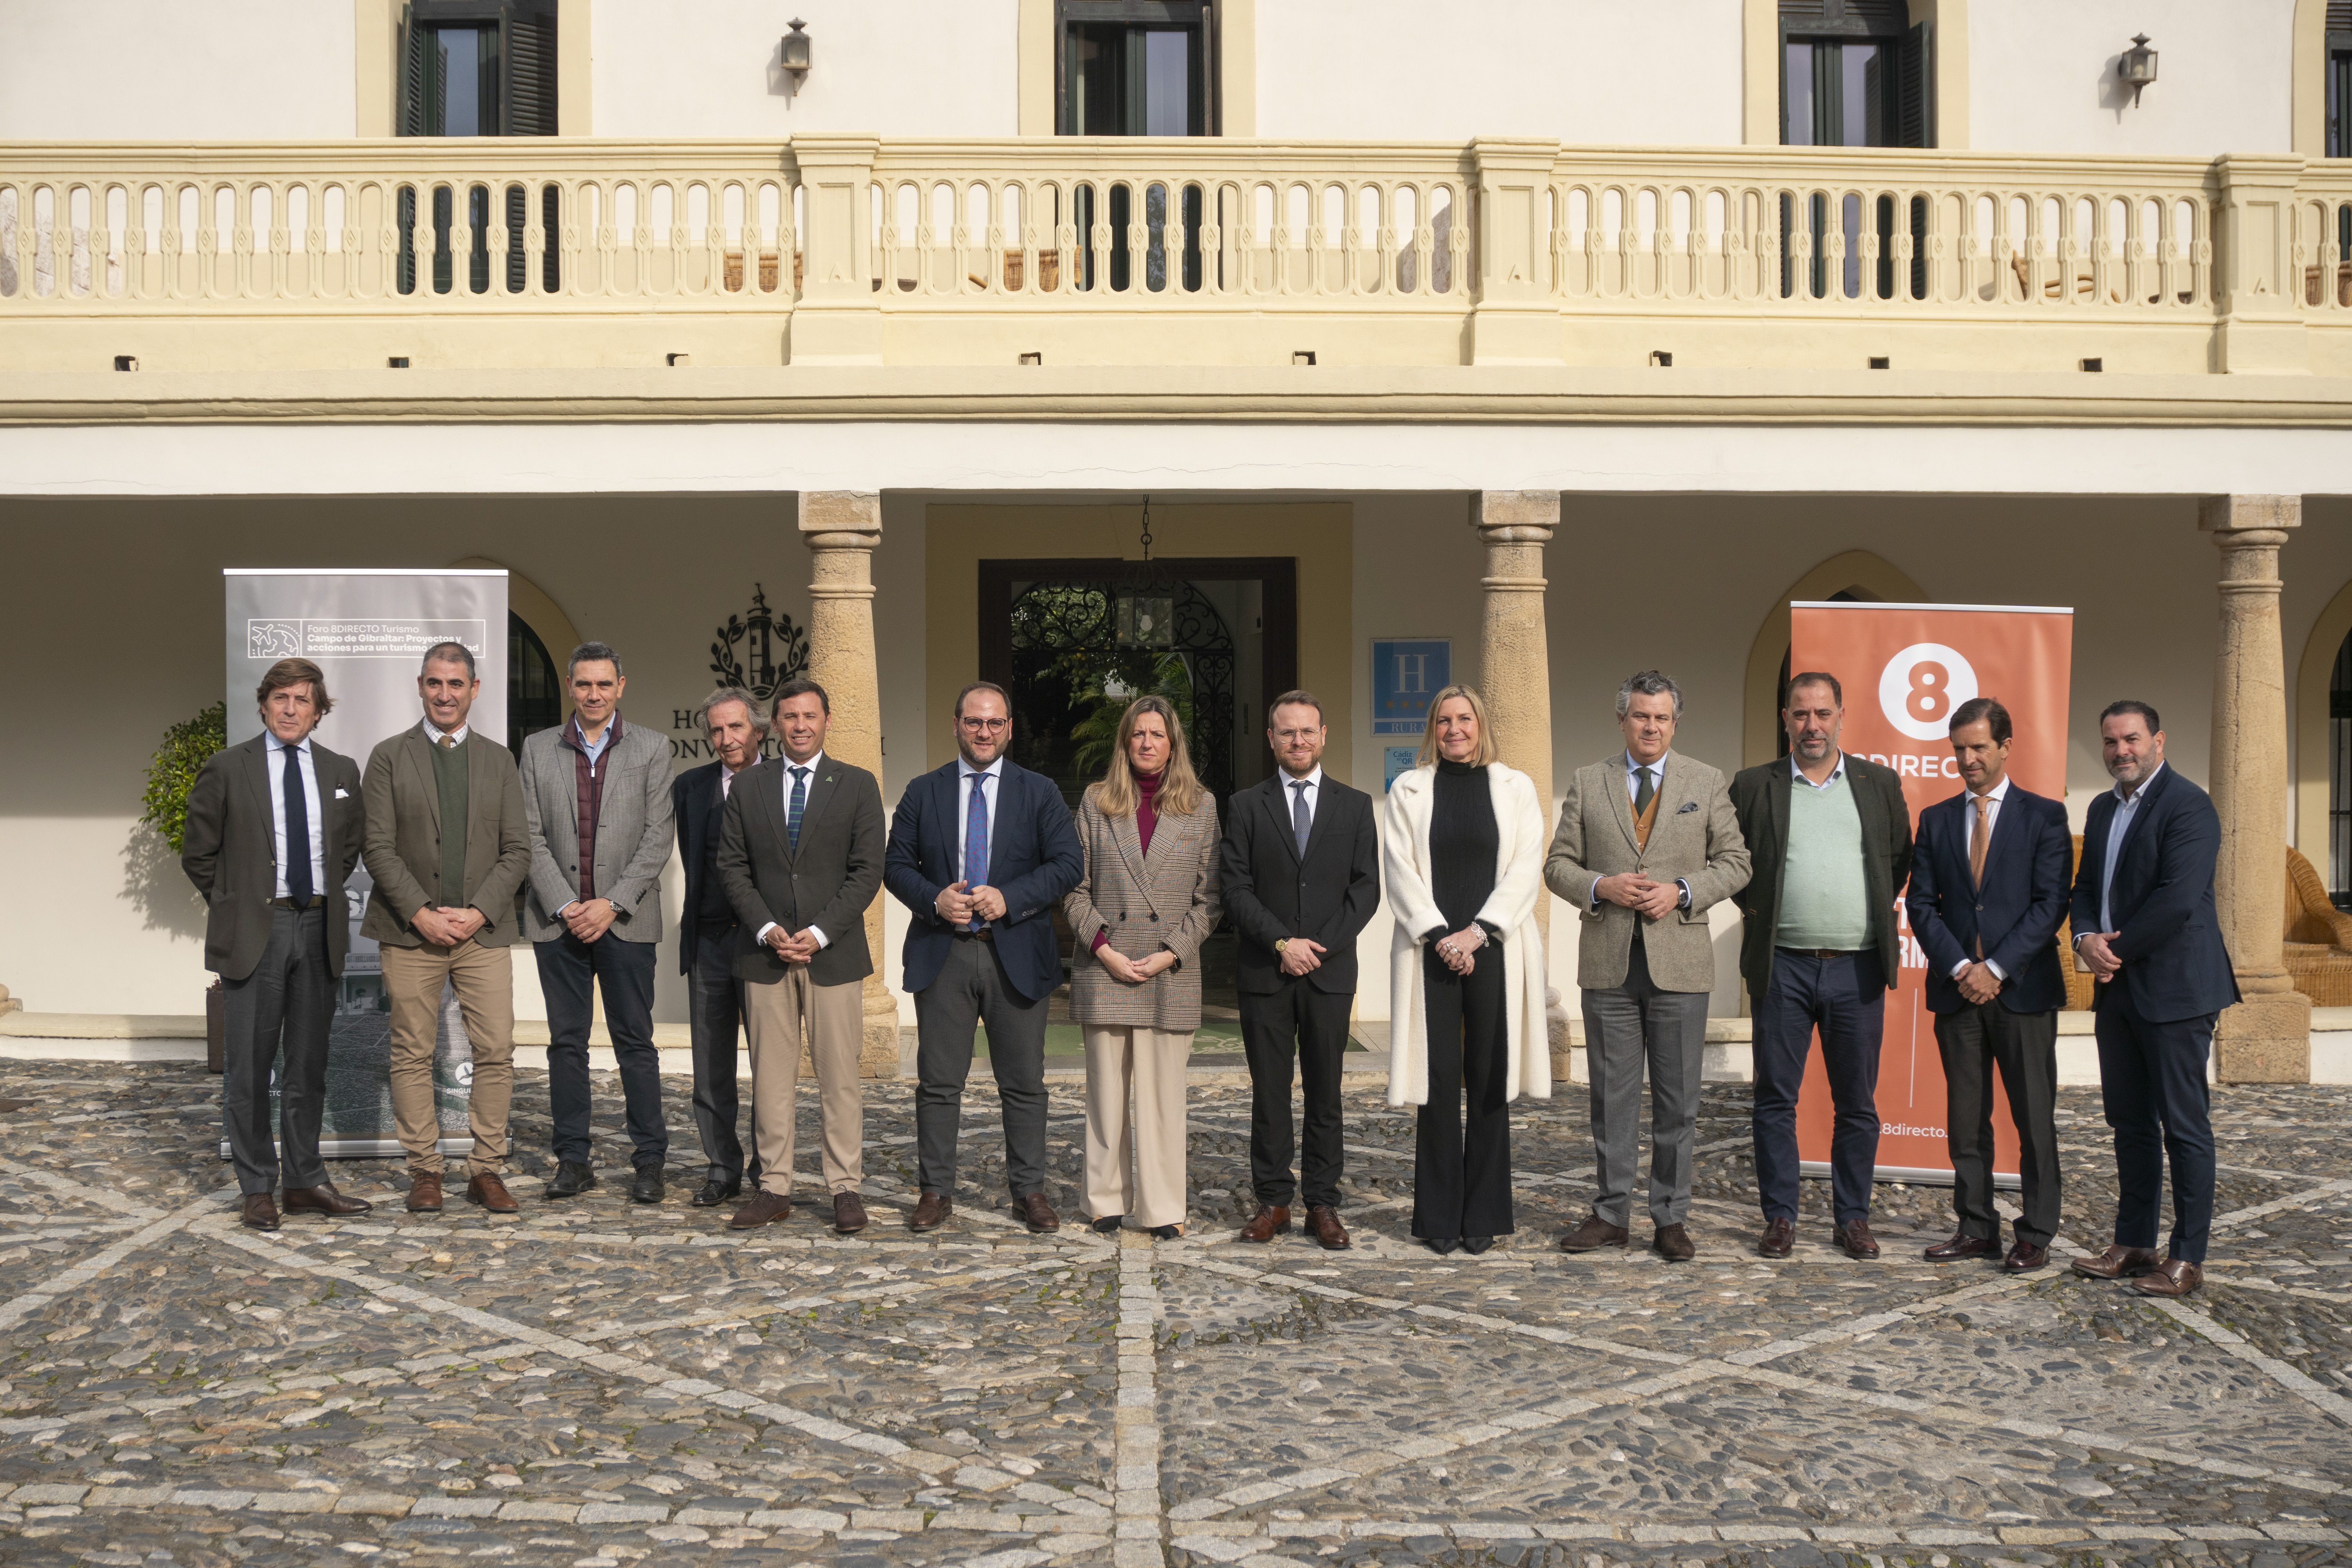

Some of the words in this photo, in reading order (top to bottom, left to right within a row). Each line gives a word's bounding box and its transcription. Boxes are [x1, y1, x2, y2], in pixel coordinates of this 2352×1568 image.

[381, 625, 419, 633] Turismo
[307, 634, 343, 644] Campo
[358, 634, 404, 642] Gibraltar:
[406, 635, 454, 644] Proyectos
[307, 643, 351, 652] acciones
[1394, 654, 1429, 693] H
[1906, 661, 1950, 722] 8
[1392, 722, 1425, 732] RURA
[1851, 753, 1960, 779] DIREC
[1879, 1123, 1948, 1138] .8directo.
